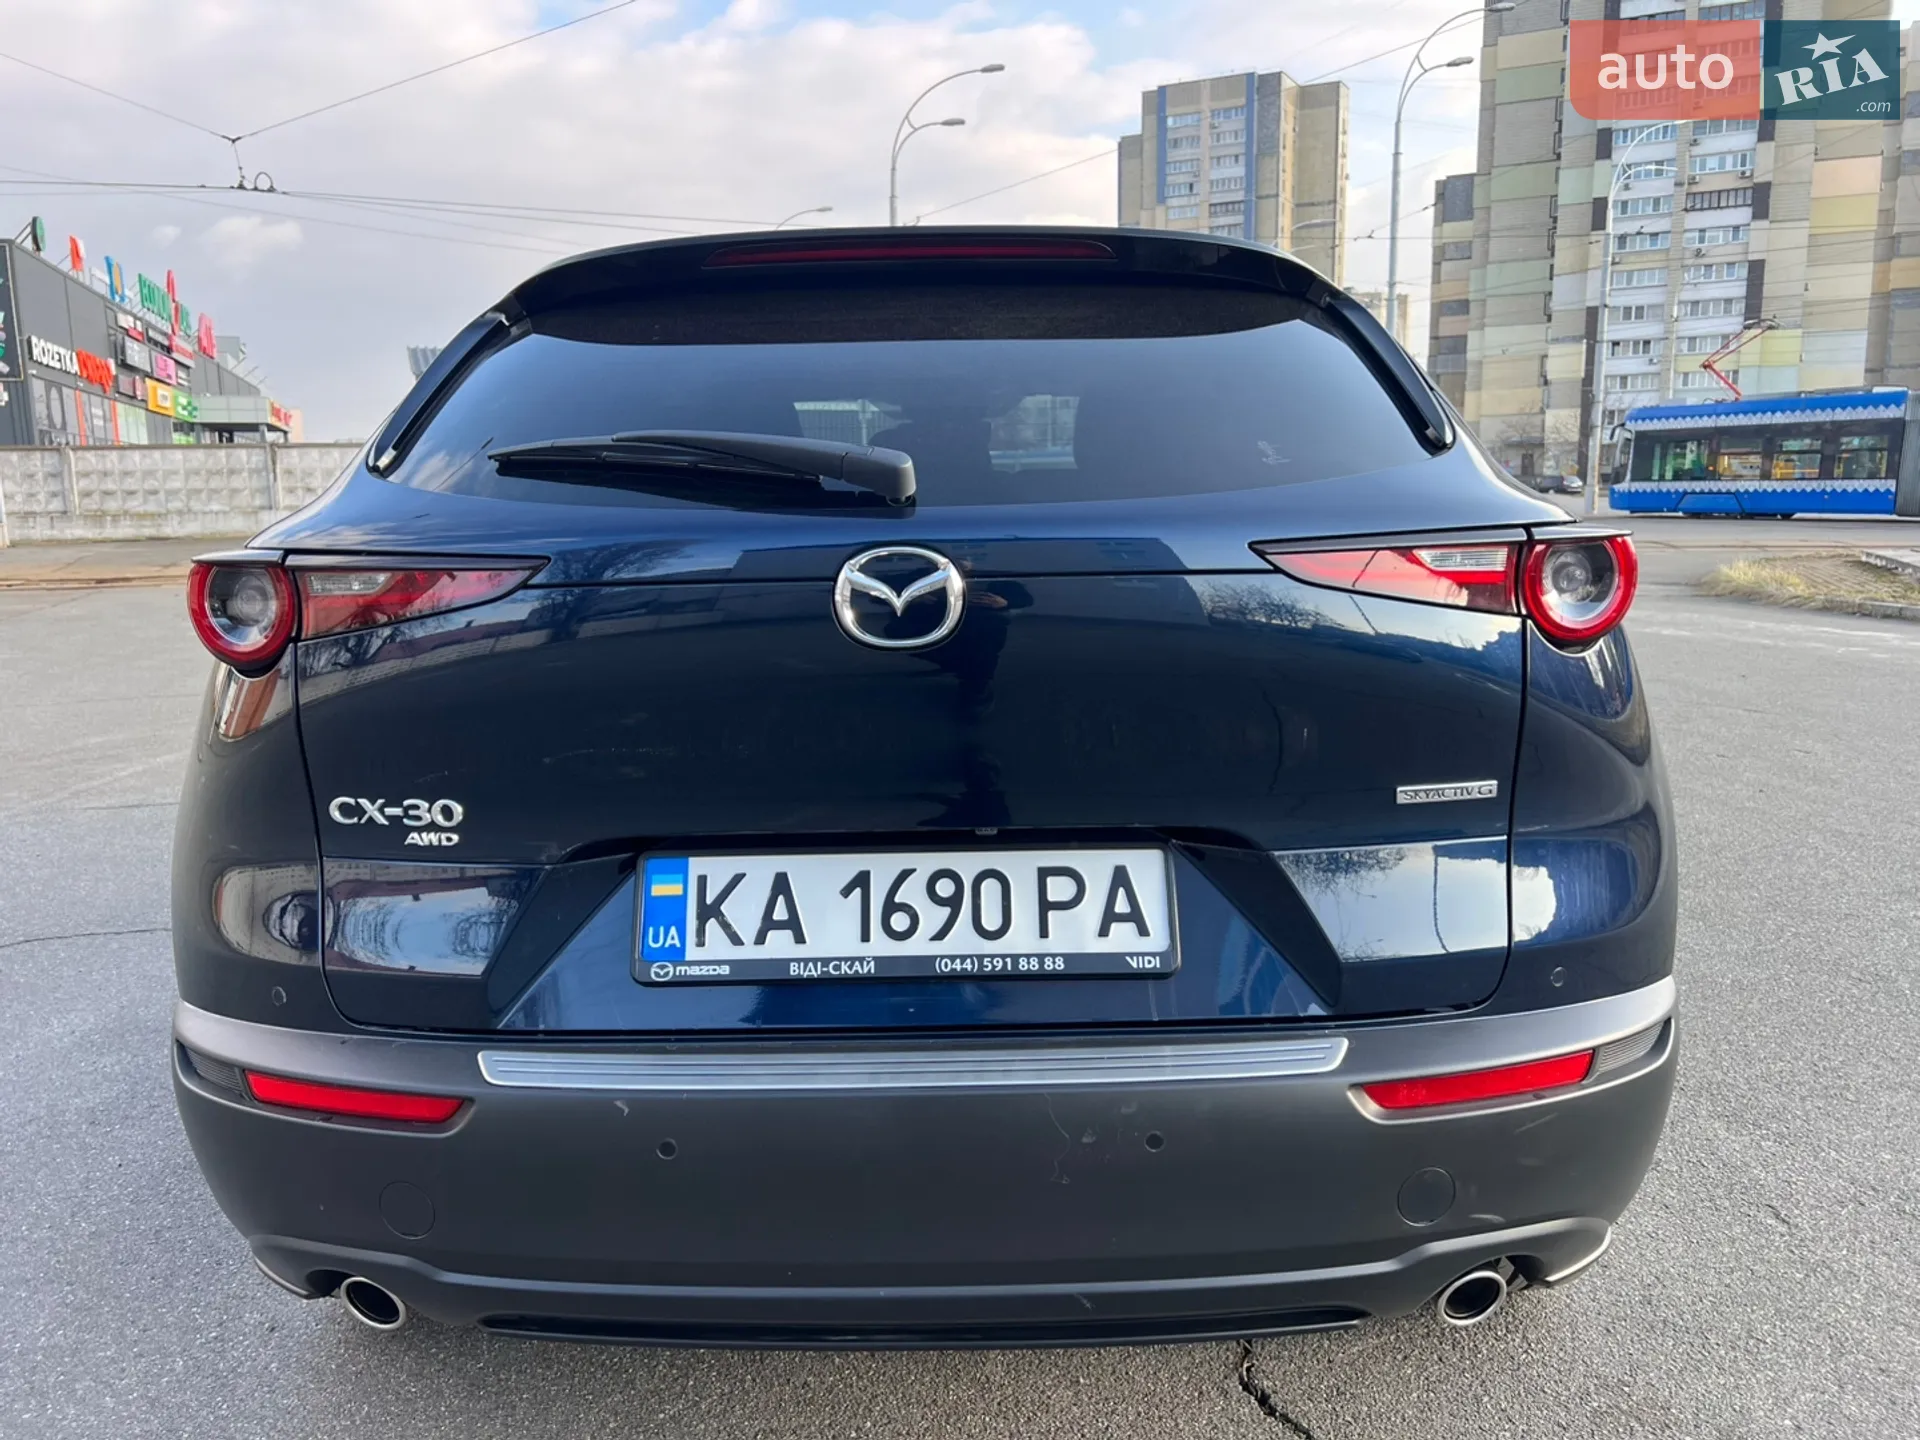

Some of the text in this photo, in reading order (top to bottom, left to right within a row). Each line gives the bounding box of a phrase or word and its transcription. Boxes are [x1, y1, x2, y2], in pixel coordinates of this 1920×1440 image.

[31, 335, 80, 376] ROZETKA
[328, 796, 463, 827] CX-30
[404, 831, 459, 846] AWD
[695, 865, 1151, 948] KA 1690 PA
[648, 926, 681, 948] UA
[789, 958, 875, 978] ВІДІ-СКАЙ
[935, 956, 1065, 973] (044) 591 88 88
[1125, 956, 1160, 969] VIDI
